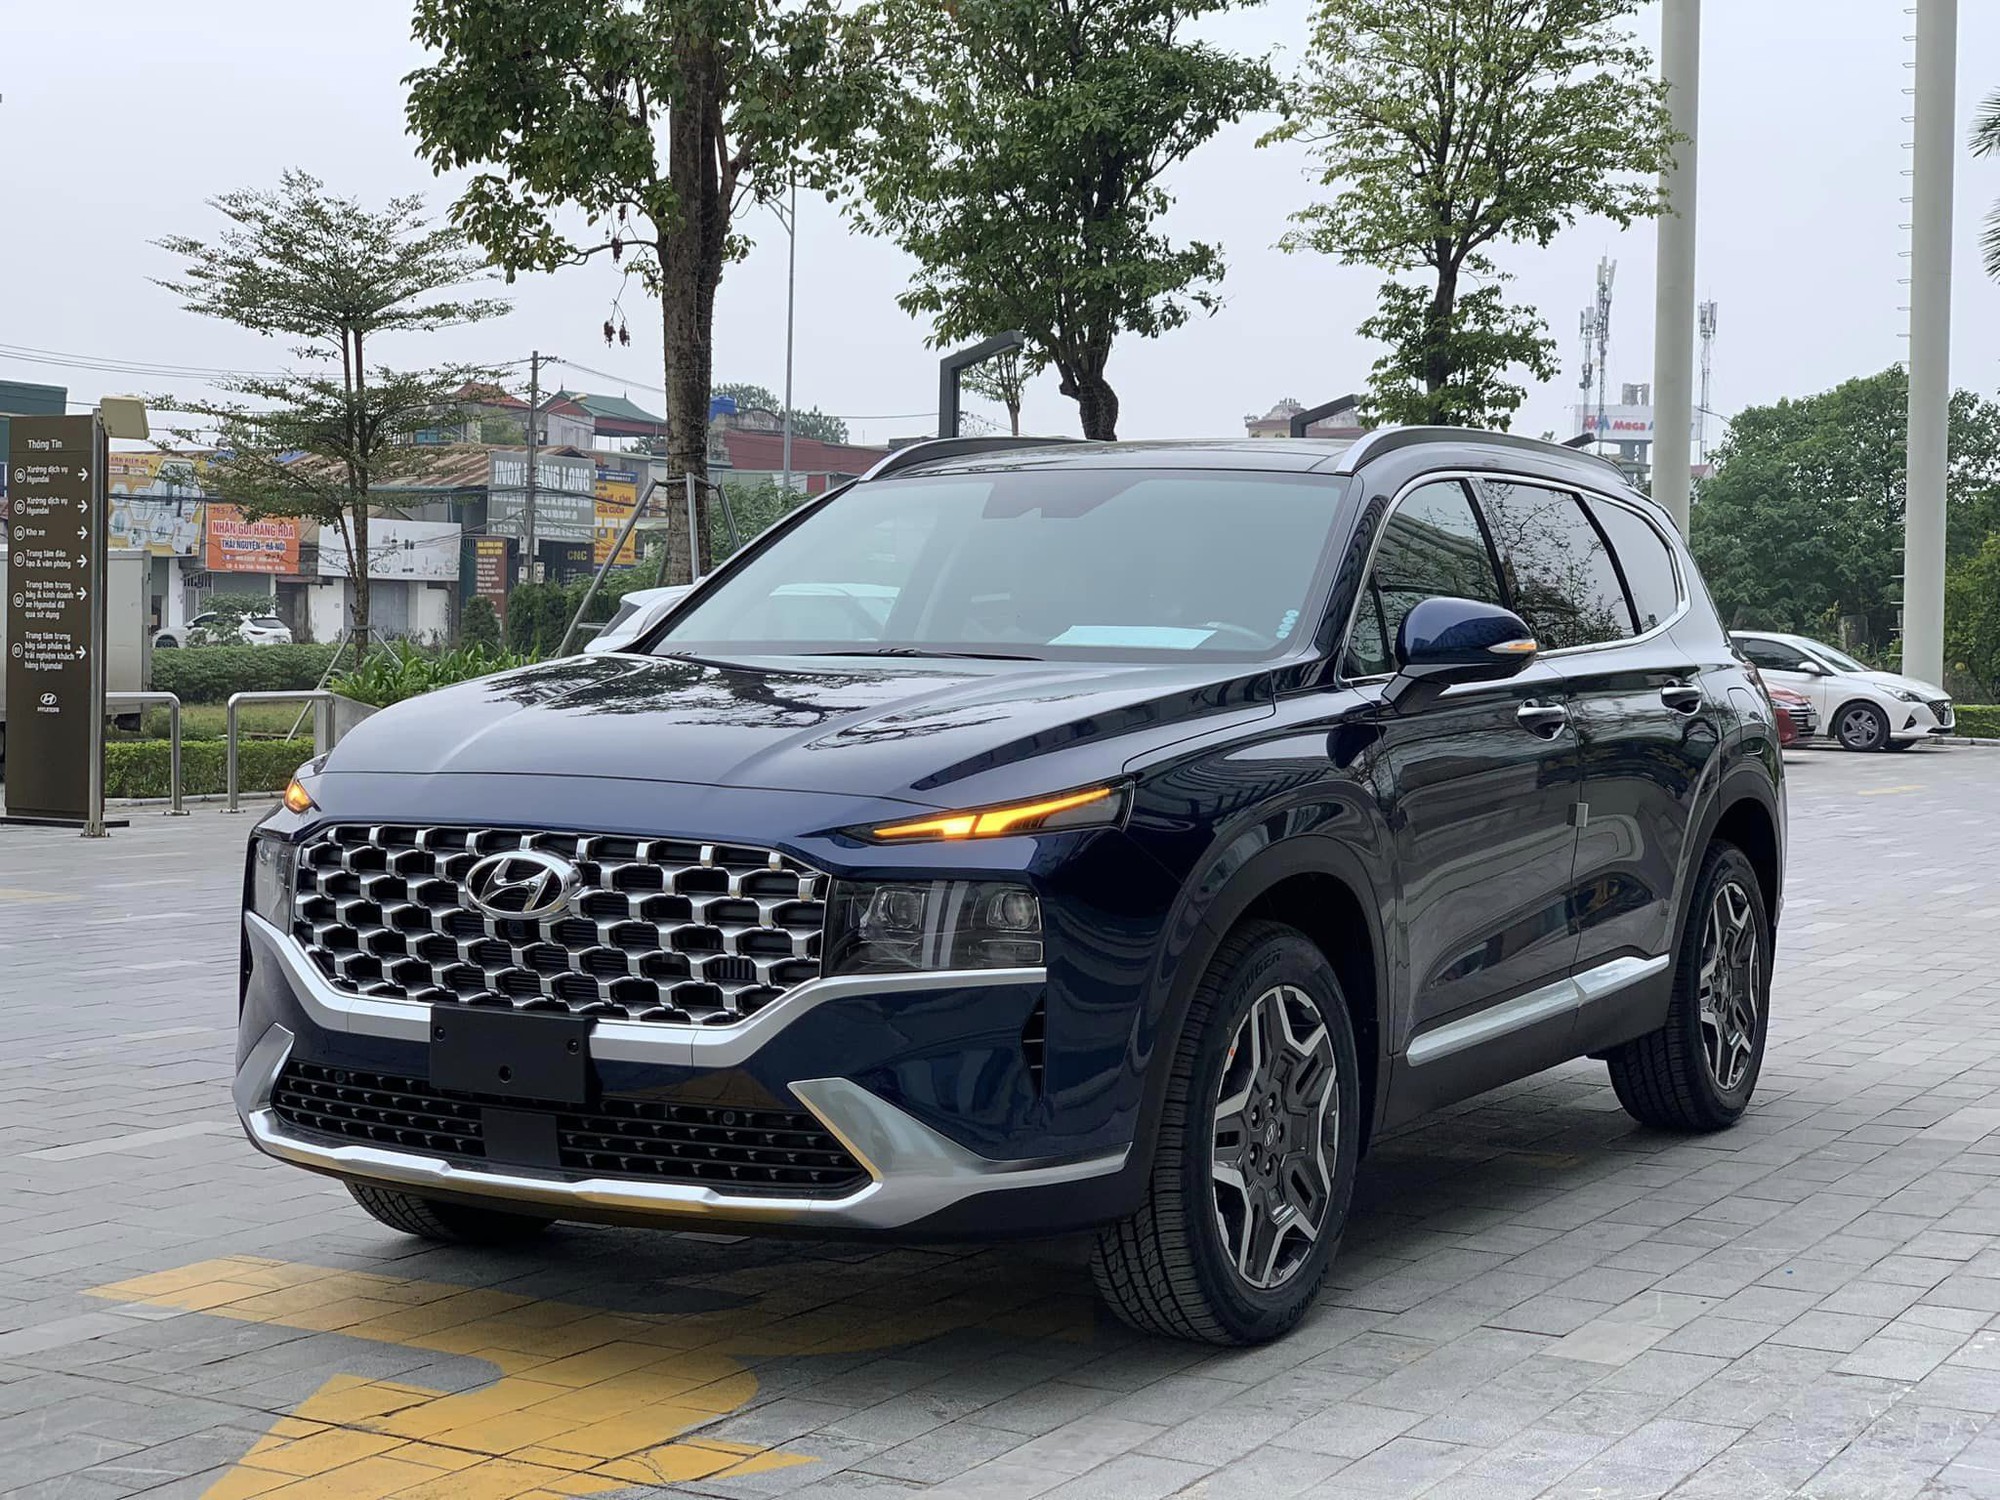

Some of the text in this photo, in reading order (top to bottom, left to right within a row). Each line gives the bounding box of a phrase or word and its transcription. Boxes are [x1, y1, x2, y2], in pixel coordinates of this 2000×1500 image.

[51, 439, 63, 449] Tin
[494, 460, 521, 485] INOX
[562, 467, 589, 491] LONG
[567, 550, 587, 561] CNC
